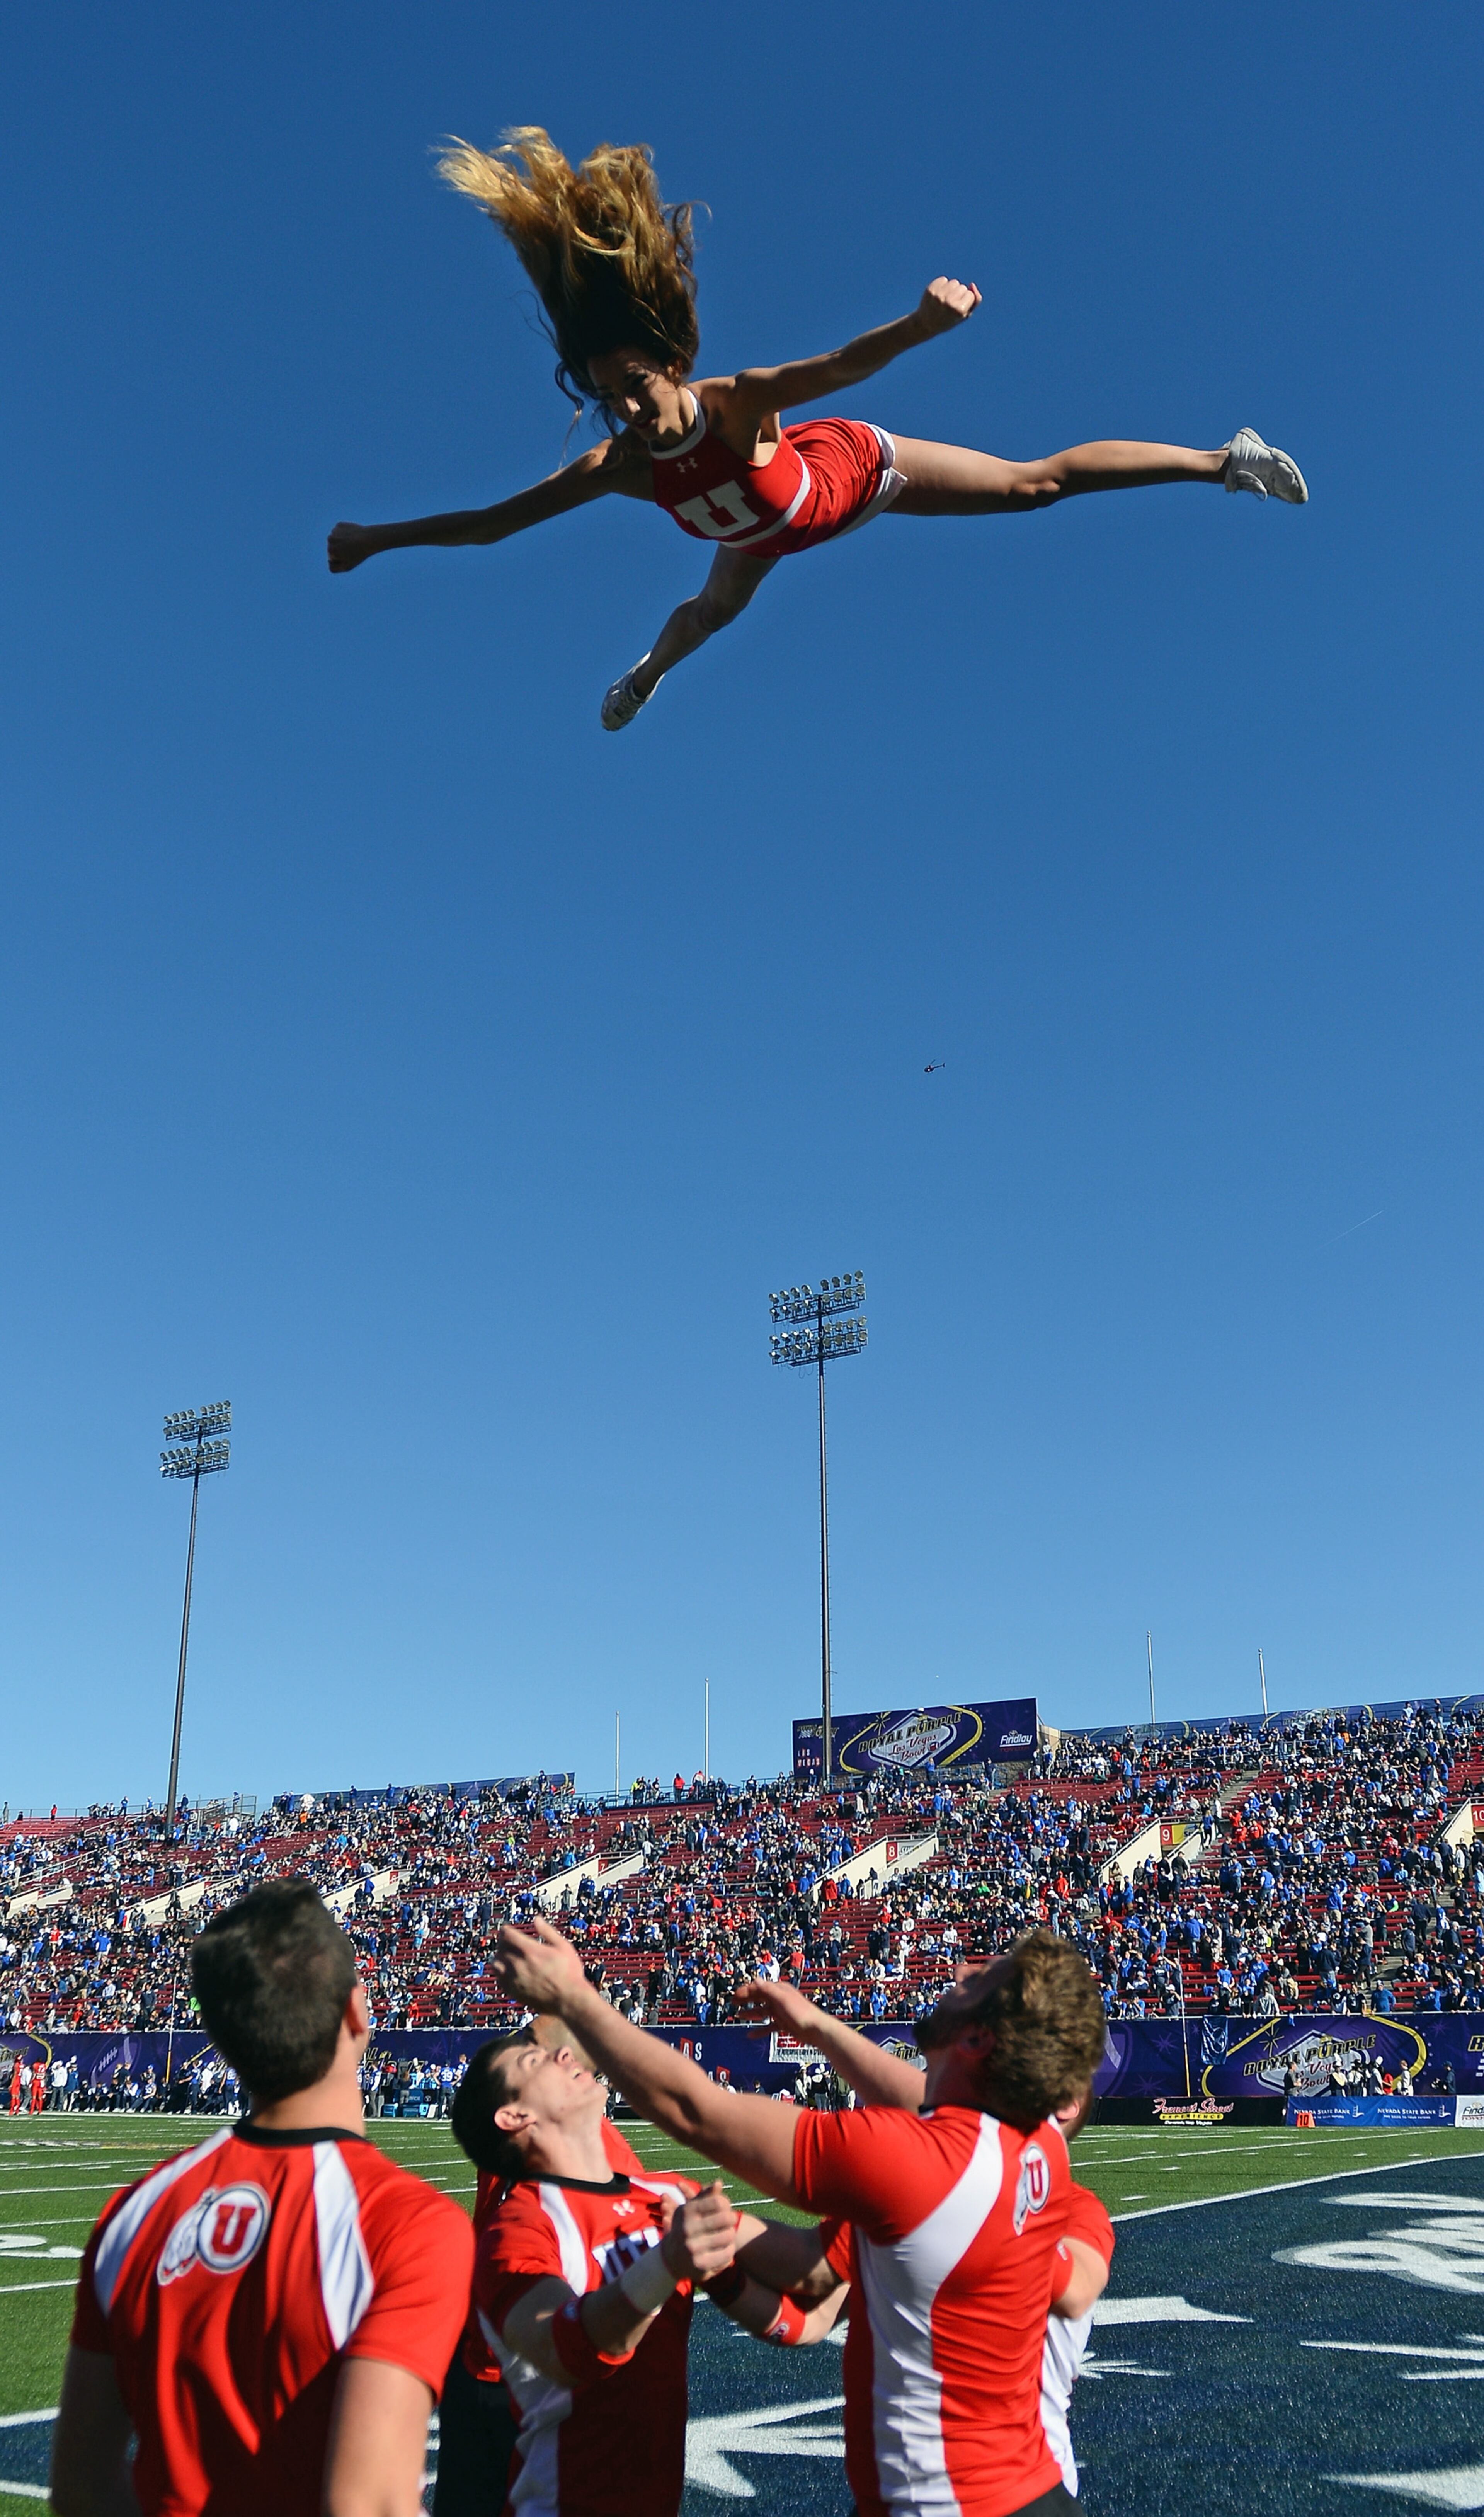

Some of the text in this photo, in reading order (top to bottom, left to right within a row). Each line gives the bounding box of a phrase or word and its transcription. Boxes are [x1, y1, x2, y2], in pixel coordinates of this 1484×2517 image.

[674, 480, 760, 536] U
[858, 1729, 903, 1753] ROYAL
[906, 1712, 961, 1735] PURPLE
[889, 1734, 937, 1756] Las Vegas
[1000, 1734, 1032, 1747] Findlay
[797, 1757, 820, 1767] VEGAS
[1162, 1829, 1170, 1841] 9
[889, 1846, 895, 1857] 8
[1244, 2035, 1376, 2076] ROYAL PURPLE
[1305, 2061, 1333, 2074] Veg
[1463, 2106, 1484, 2114] Find
[1300, 2115, 1309, 2125] 10
[1028, 2159, 1043, 2200] U
[212, 2204, 257, 2256] U
